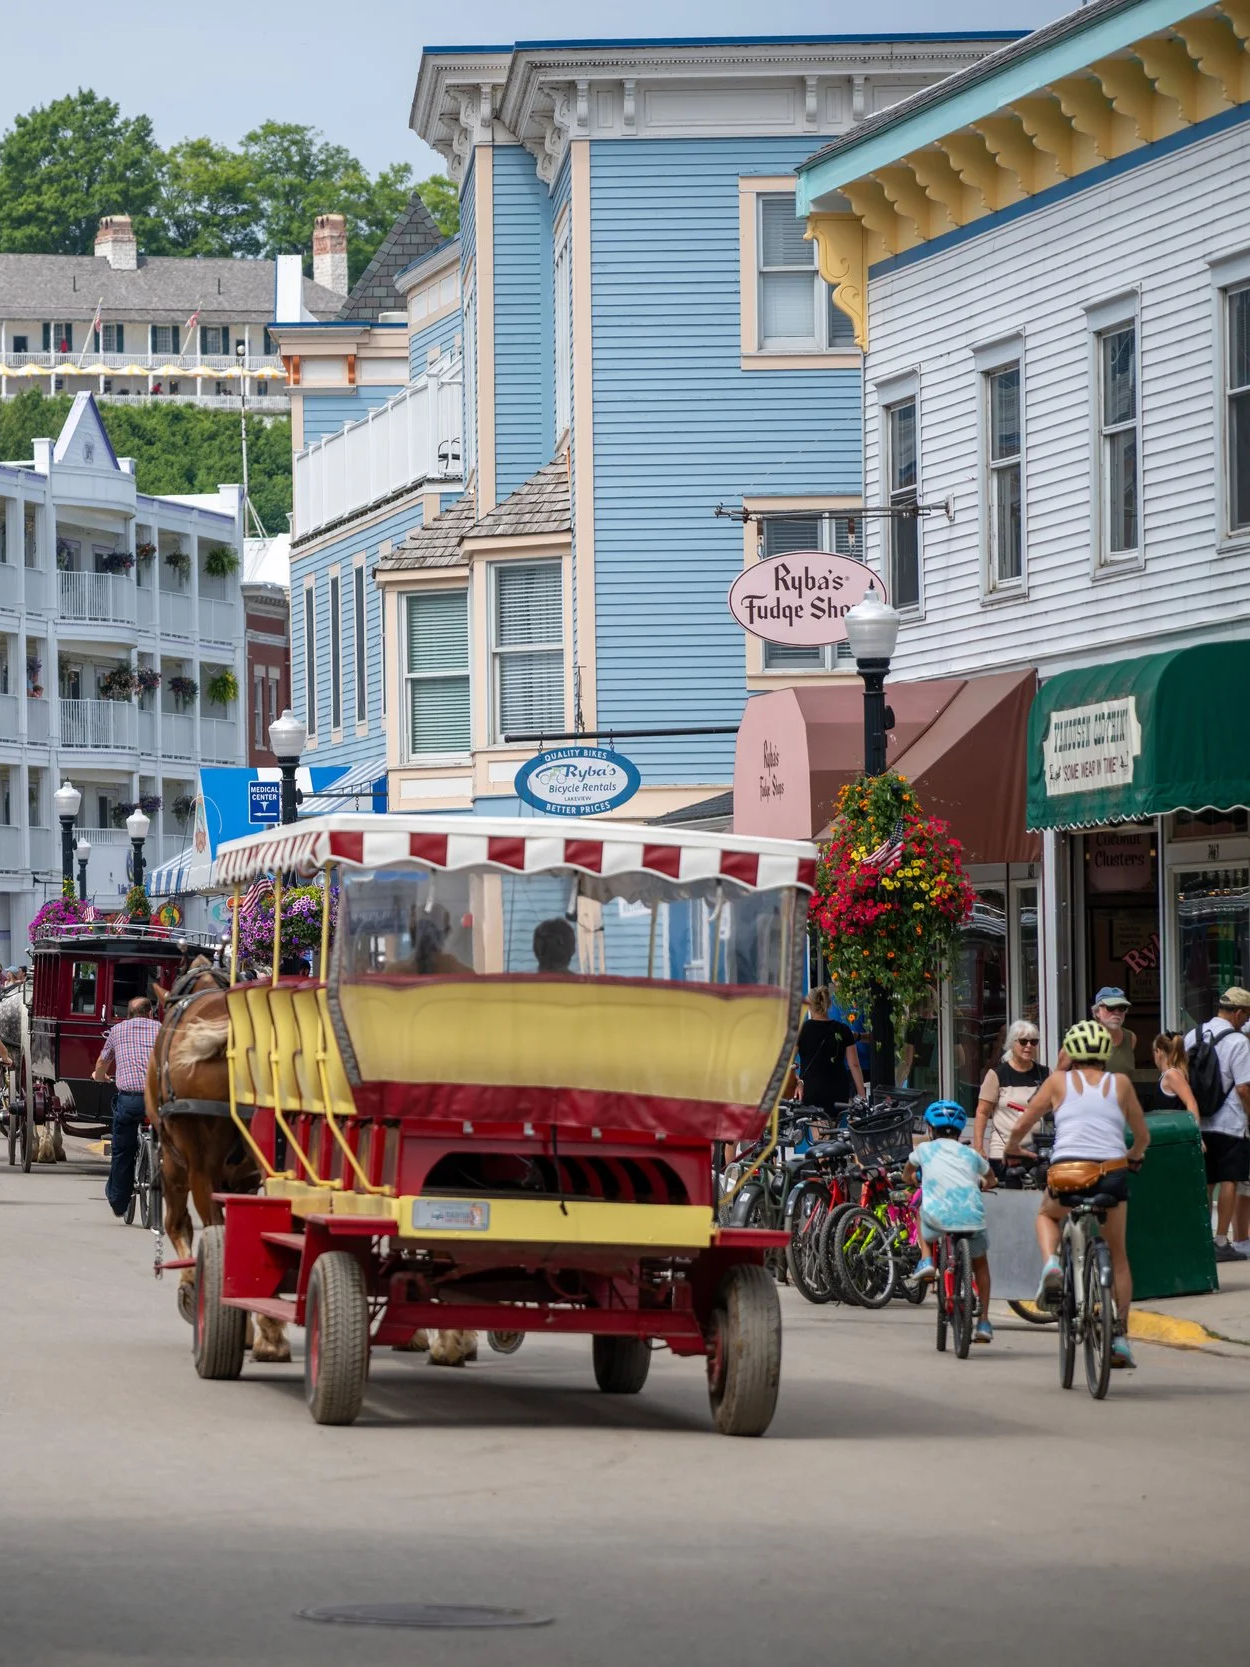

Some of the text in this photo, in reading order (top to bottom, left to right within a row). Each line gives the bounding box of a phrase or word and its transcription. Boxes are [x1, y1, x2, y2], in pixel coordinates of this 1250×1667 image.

[774, 562, 844, 599] Ryba's
[741, 594, 856, 627] Fudge Sho
[544, 750, 607, 762] QUALITY BIKES
[536, 764, 617, 783] Ryba's
[549, 782, 617, 795] Bicycle Rentals
[546, 801, 611, 814] BETTER PRICES
[1095, 850, 1145, 868] Clusters
